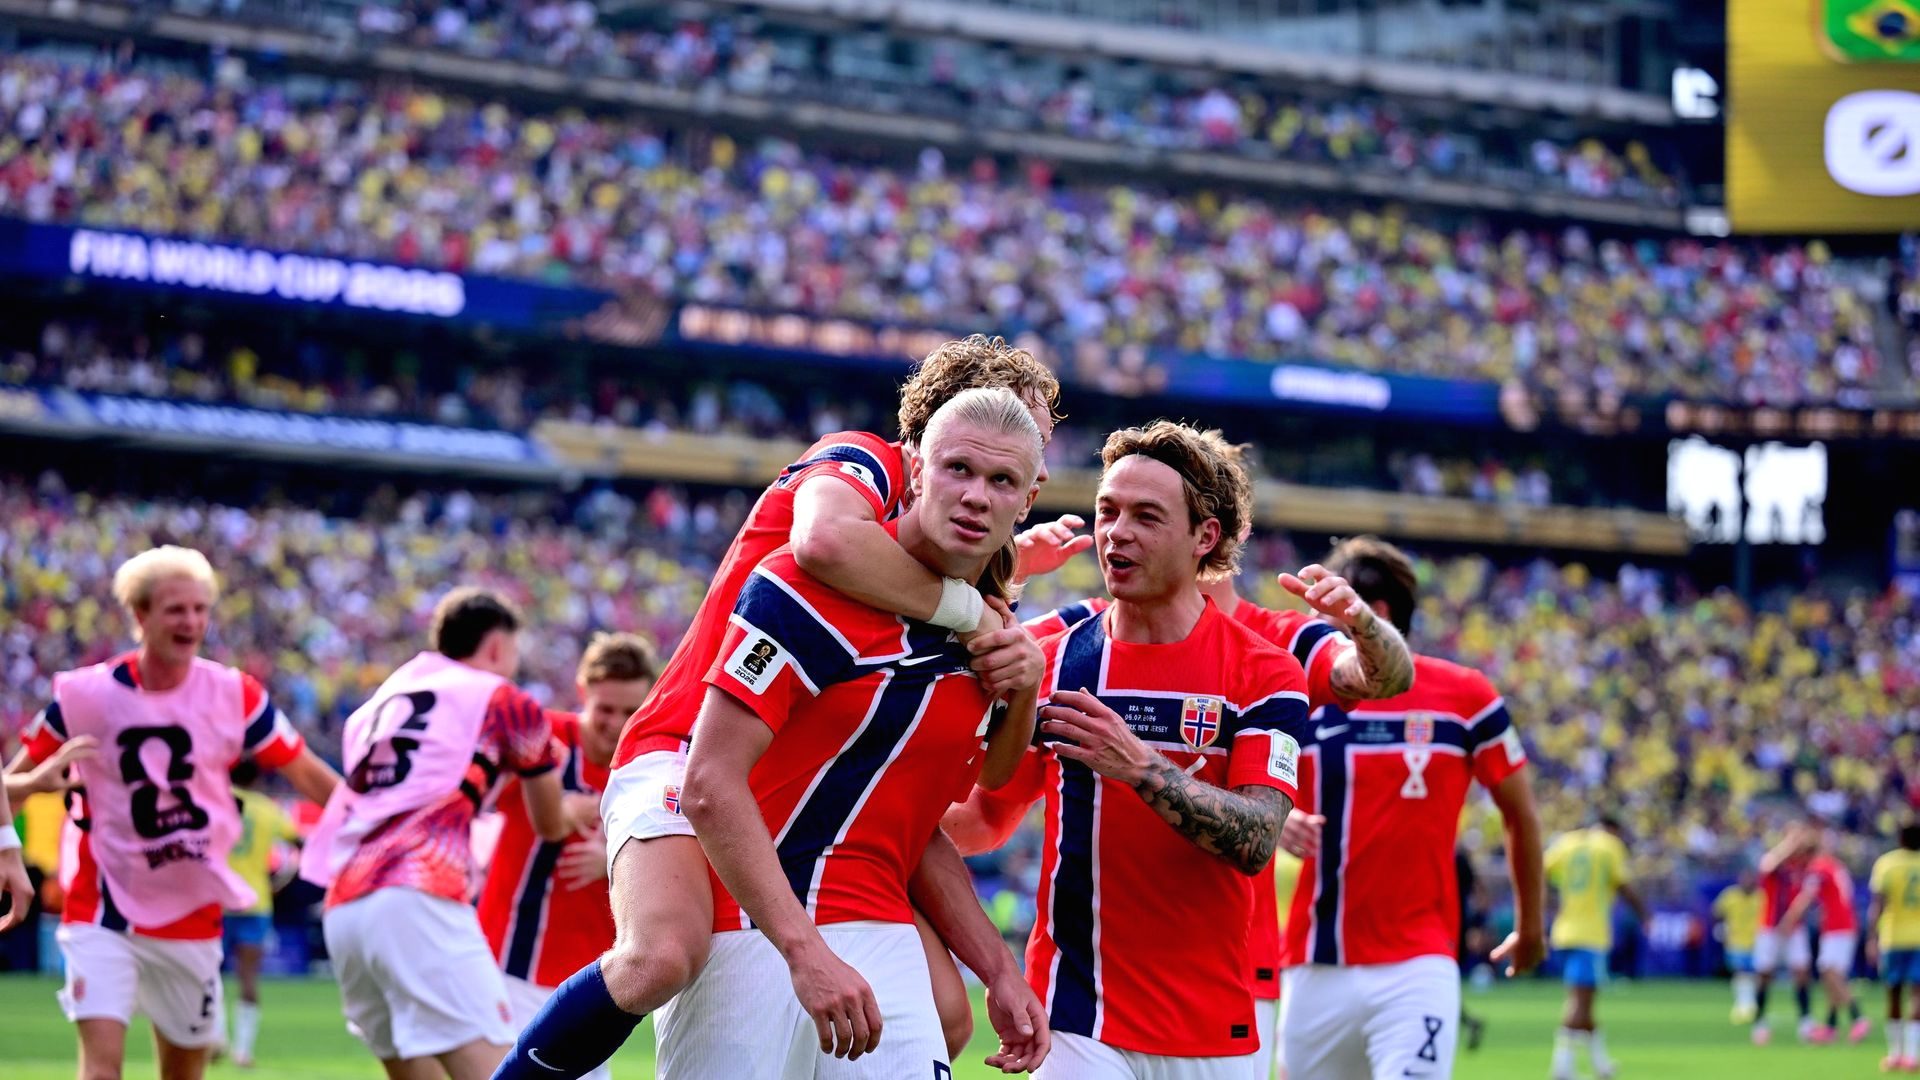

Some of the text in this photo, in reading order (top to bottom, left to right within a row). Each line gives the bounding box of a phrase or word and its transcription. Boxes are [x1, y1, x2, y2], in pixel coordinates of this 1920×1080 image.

[1823, 88, 1920, 197] 0
[70, 229, 465, 317] FIFA WORLD CUP 2026
[734, 668, 755, 685] 2026
[1137, 724, 1150, 732] NEW
[1417, 1015, 1443, 1062] 8
